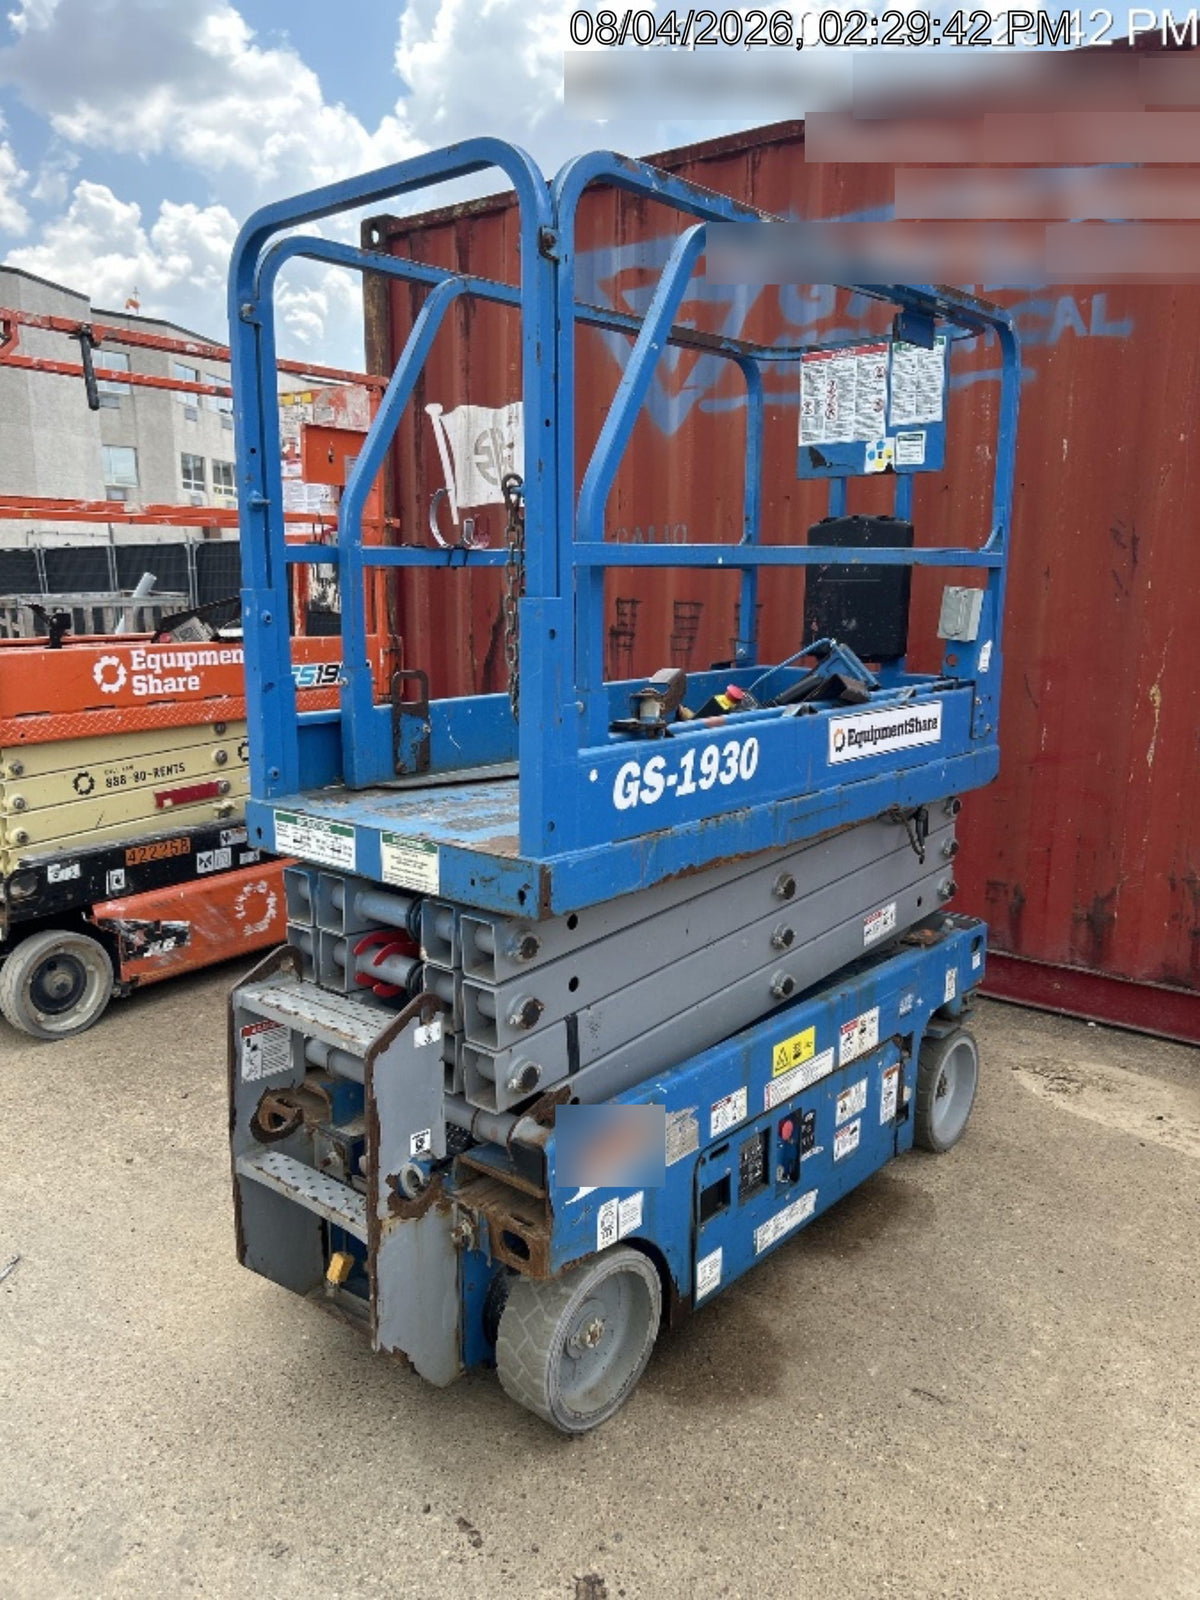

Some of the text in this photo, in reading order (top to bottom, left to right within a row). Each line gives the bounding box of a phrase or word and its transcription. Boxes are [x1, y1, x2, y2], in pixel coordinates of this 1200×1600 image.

[130, 649, 244, 674] Equipmen
[131, 674, 200, 696] Share
[847, 717, 938, 748] EquipmentShare
[613, 737, 759, 810] GS-1930
